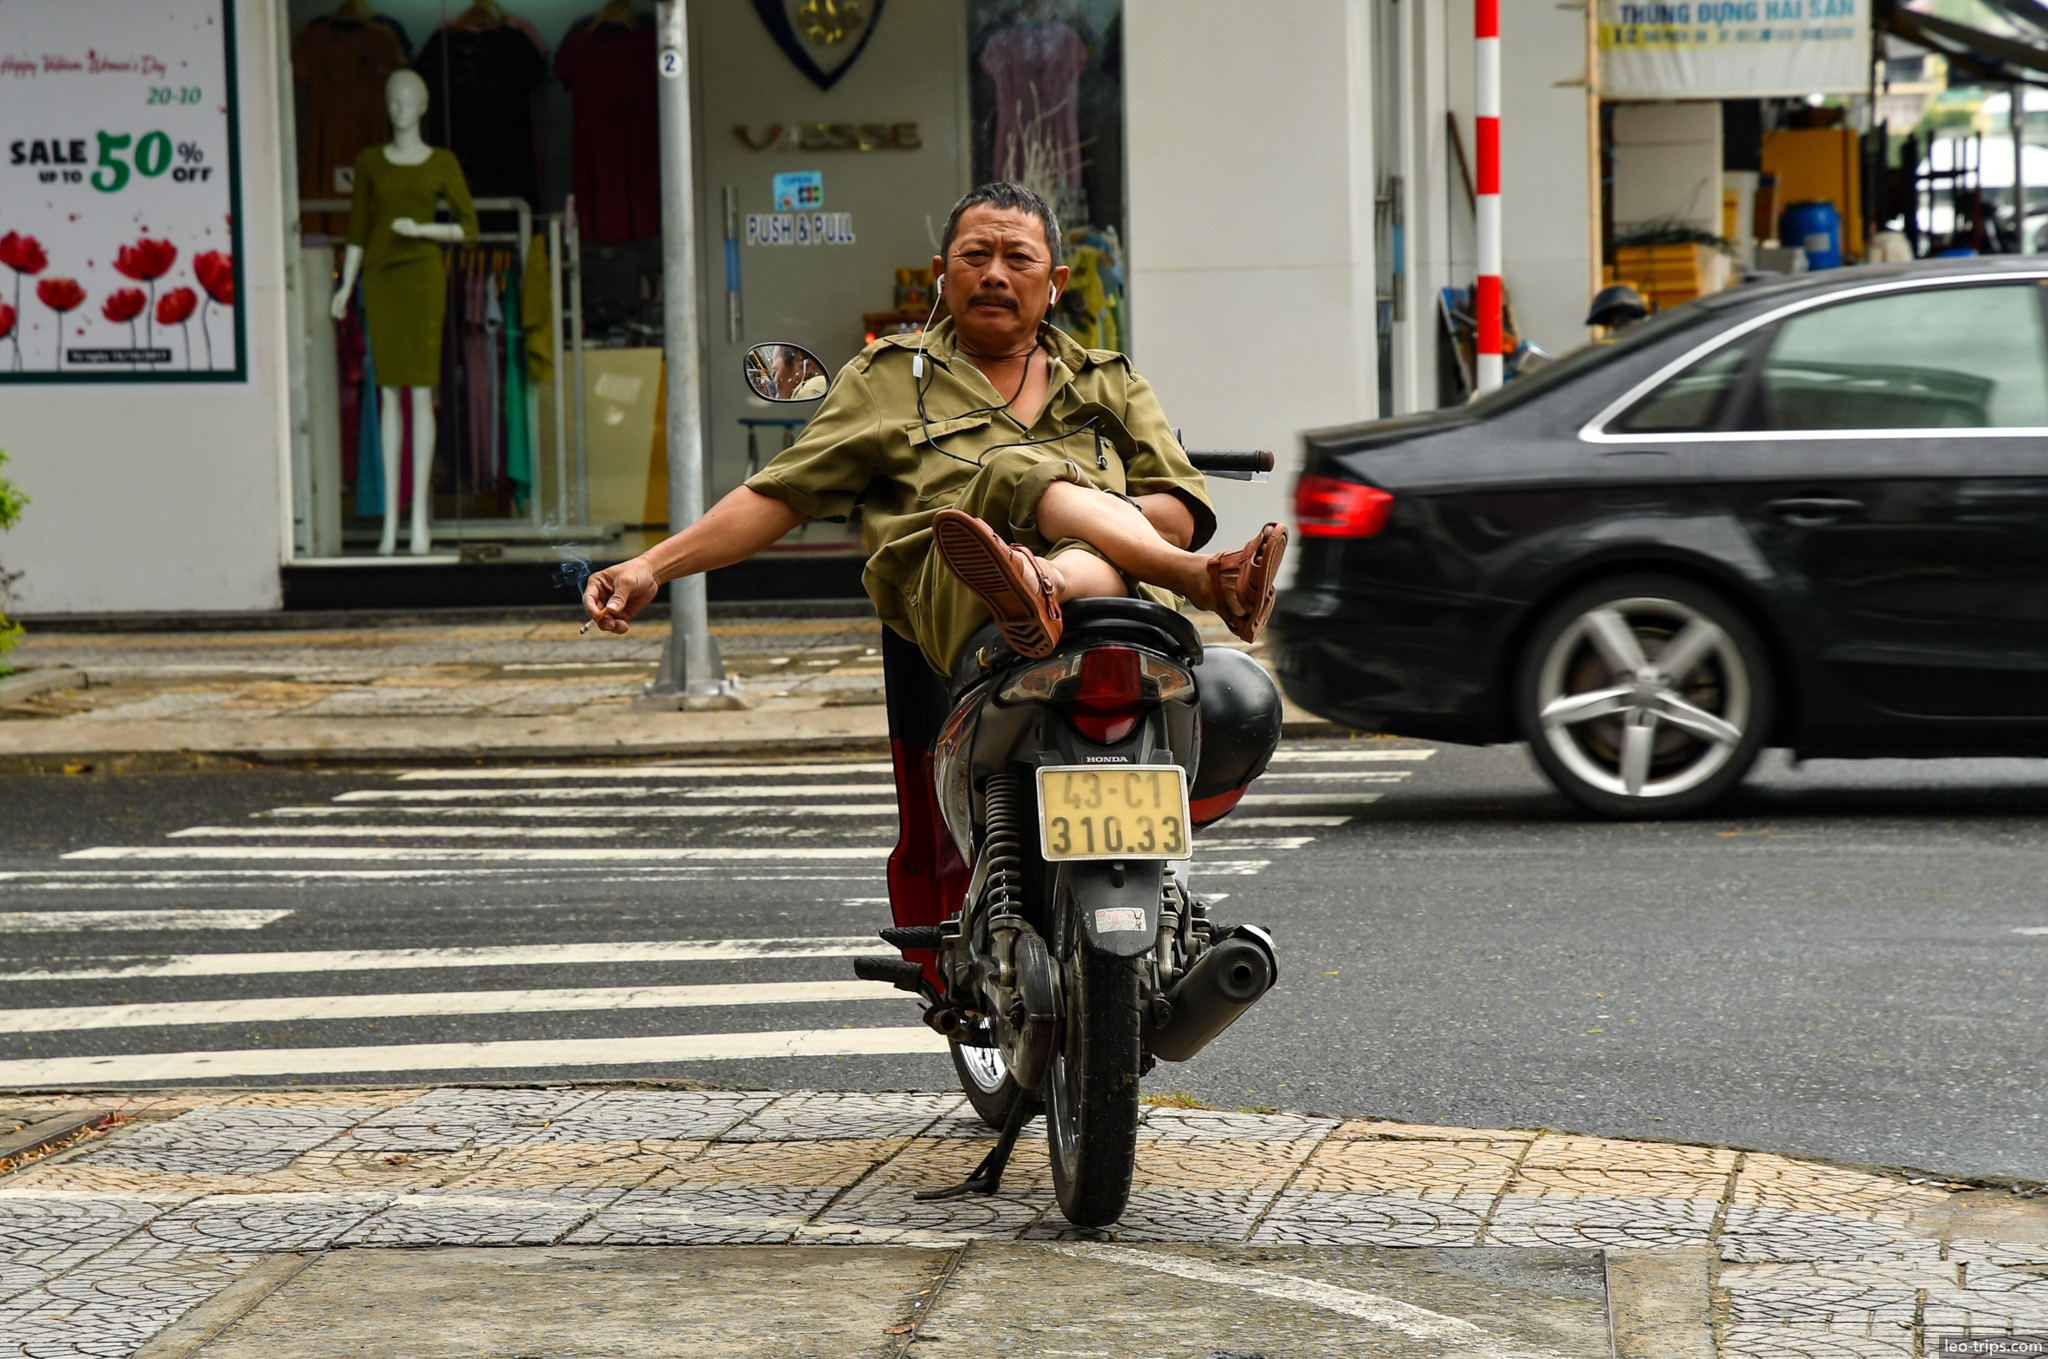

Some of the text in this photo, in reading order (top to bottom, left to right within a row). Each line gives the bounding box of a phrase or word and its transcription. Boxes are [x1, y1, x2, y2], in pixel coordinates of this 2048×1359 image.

[142, 54, 167, 79] Day
[664, 54, 676, 73] 2
[147, 87, 201, 105] 20-10
[10, 140, 87, 165] SALE
[91, 130, 203, 193] 50 %
[38, 170, 82, 183] UP TO
[172, 166, 212, 182] OFF
[748, 212, 856, 246] PUSH & PULL
[1063, 772, 1161, 810] 43-C1
[1051, 816, 1182, 855] 310.33
